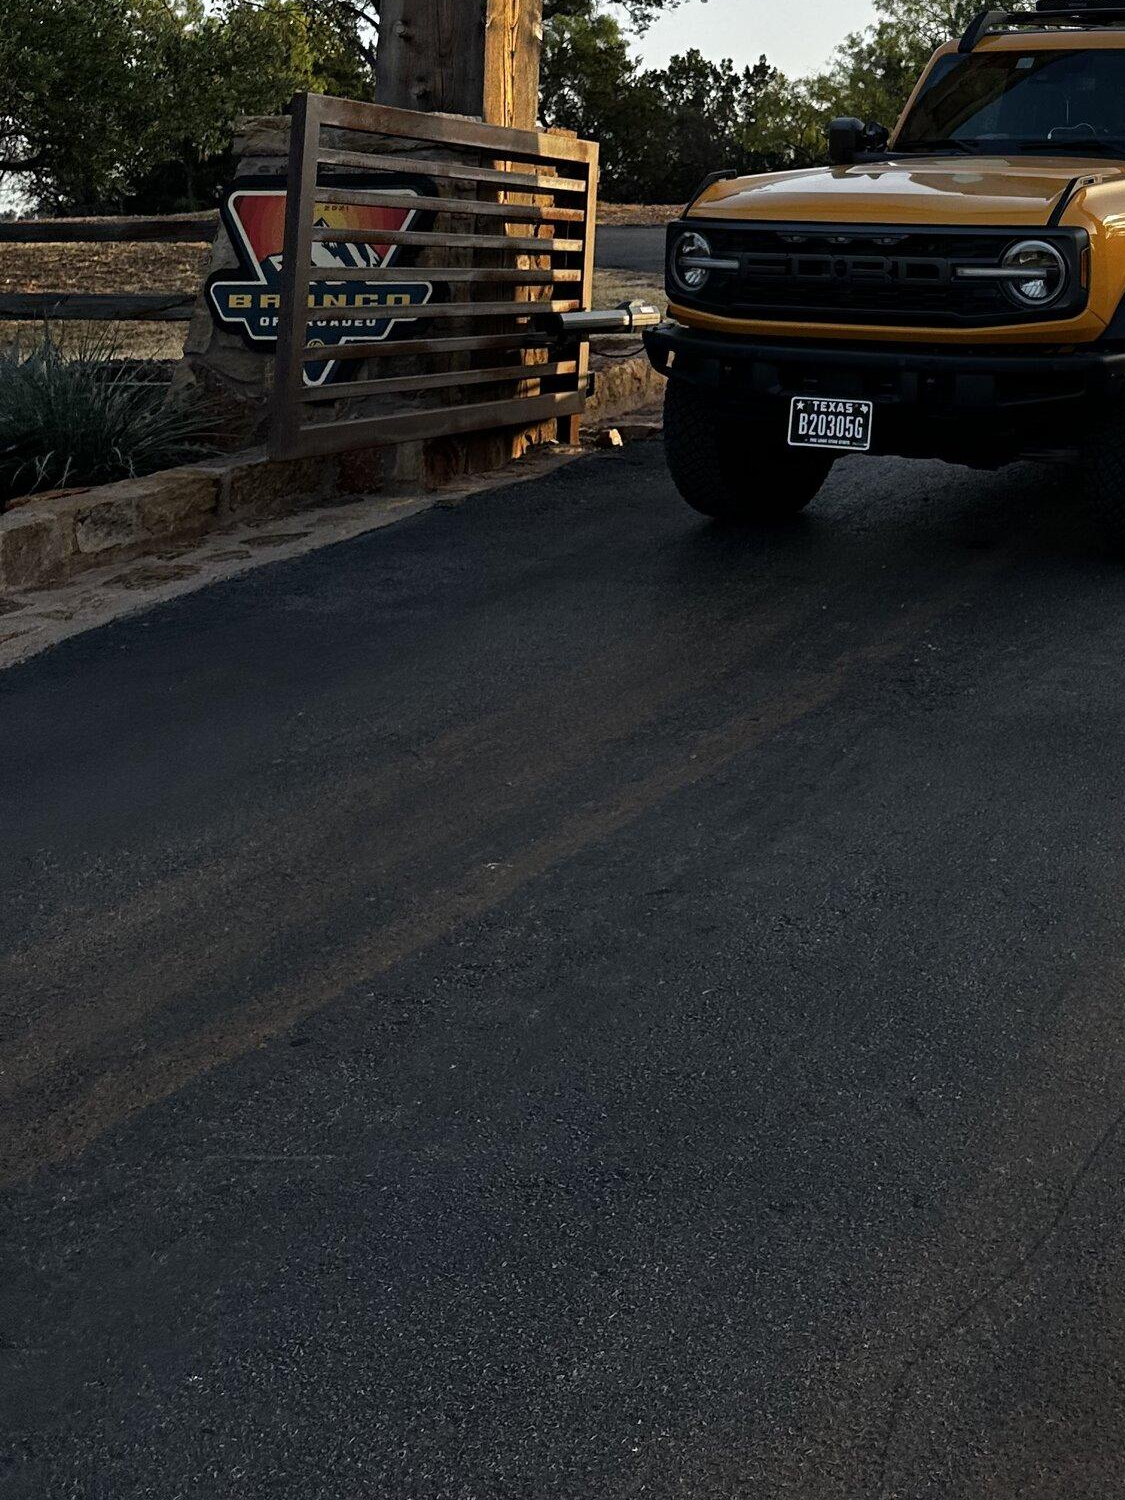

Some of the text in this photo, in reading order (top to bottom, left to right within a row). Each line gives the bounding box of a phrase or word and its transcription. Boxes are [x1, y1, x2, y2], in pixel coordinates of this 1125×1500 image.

[741, 253, 949, 286] FORD
[228, 294, 411, 309] BRNCO
[812, 401, 853, 413] TEXAS
[798, 412, 863, 439] B20305G
